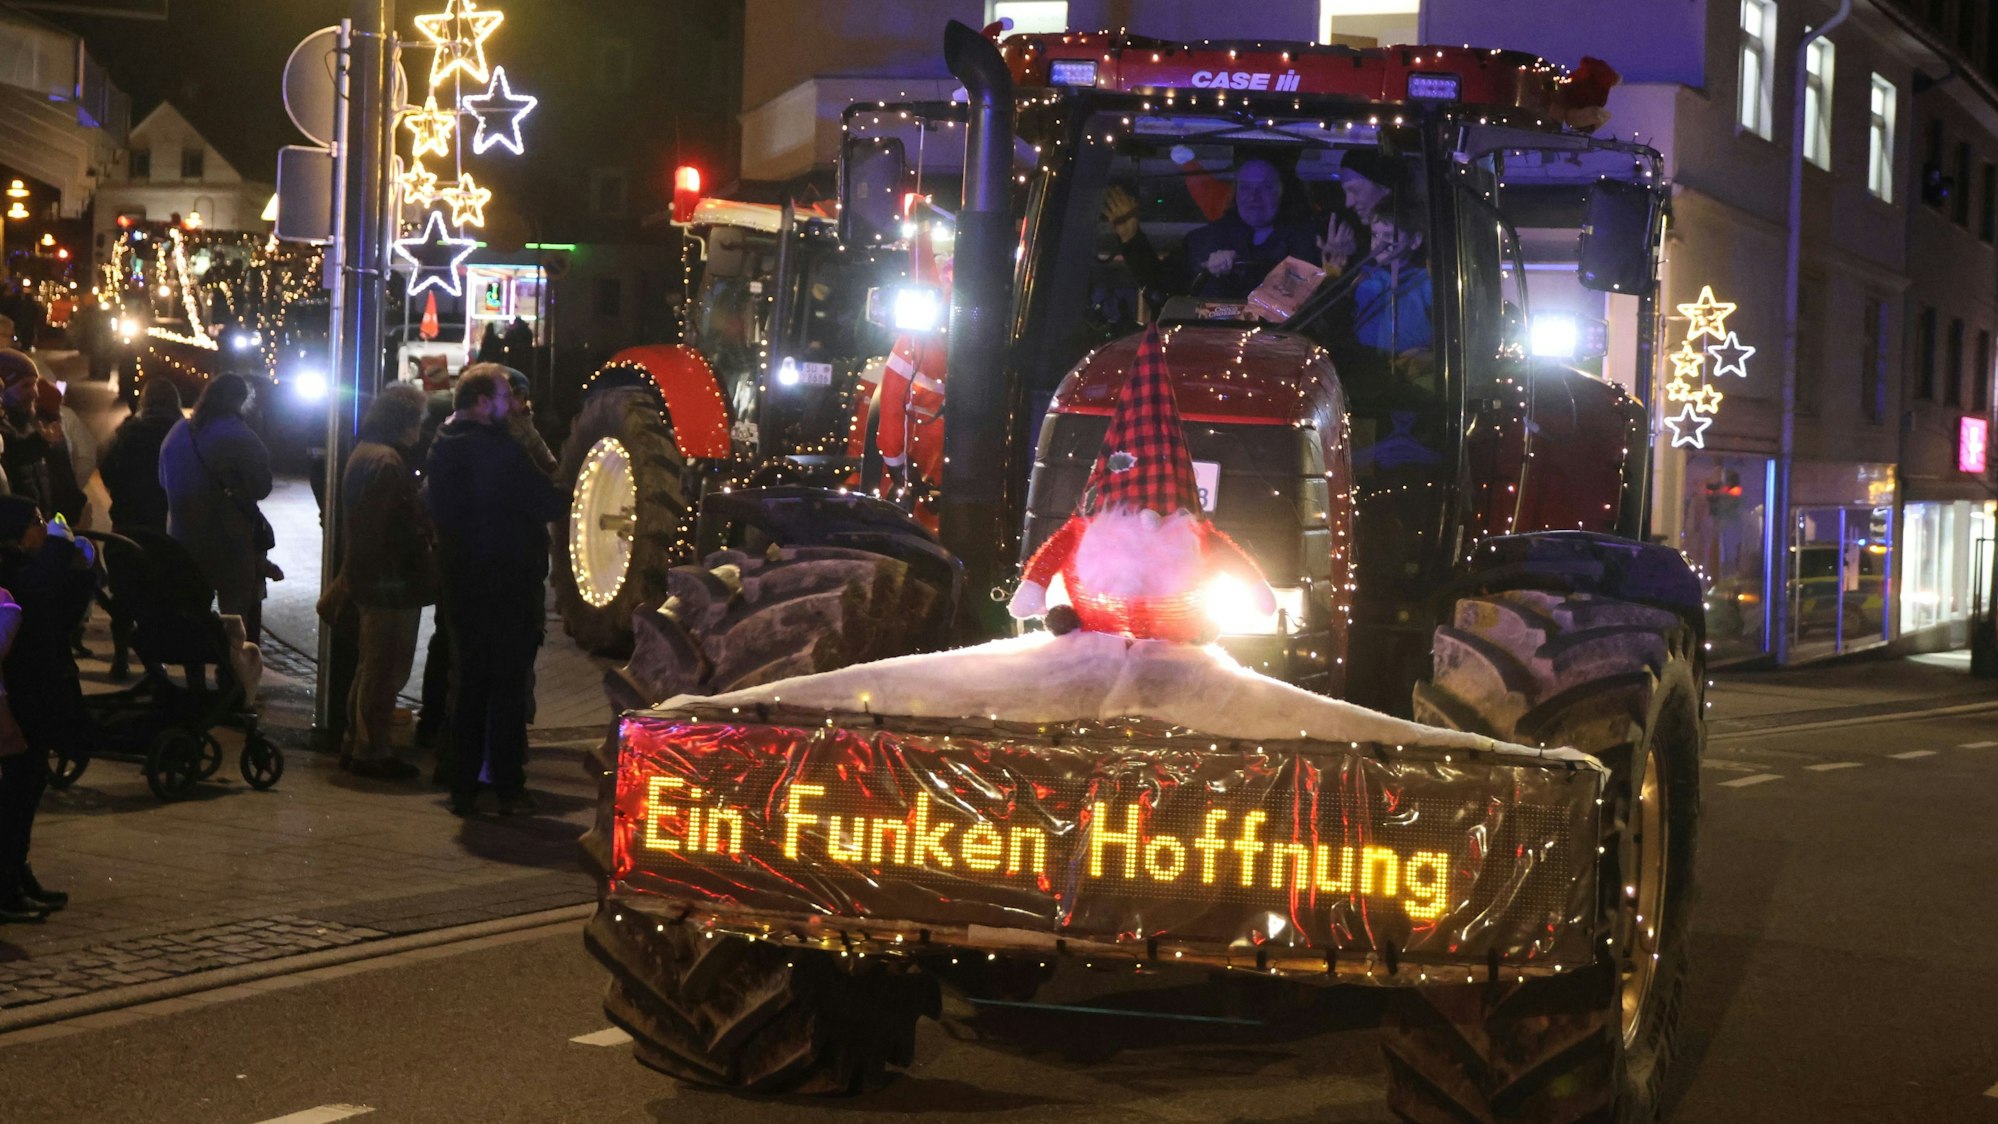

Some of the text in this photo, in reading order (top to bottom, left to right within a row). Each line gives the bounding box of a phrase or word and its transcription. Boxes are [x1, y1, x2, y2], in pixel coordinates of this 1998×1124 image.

[1191, 70, 1271, 91] CASE
[645, 776, 1449, 918] Ein Funken Hoffnung
